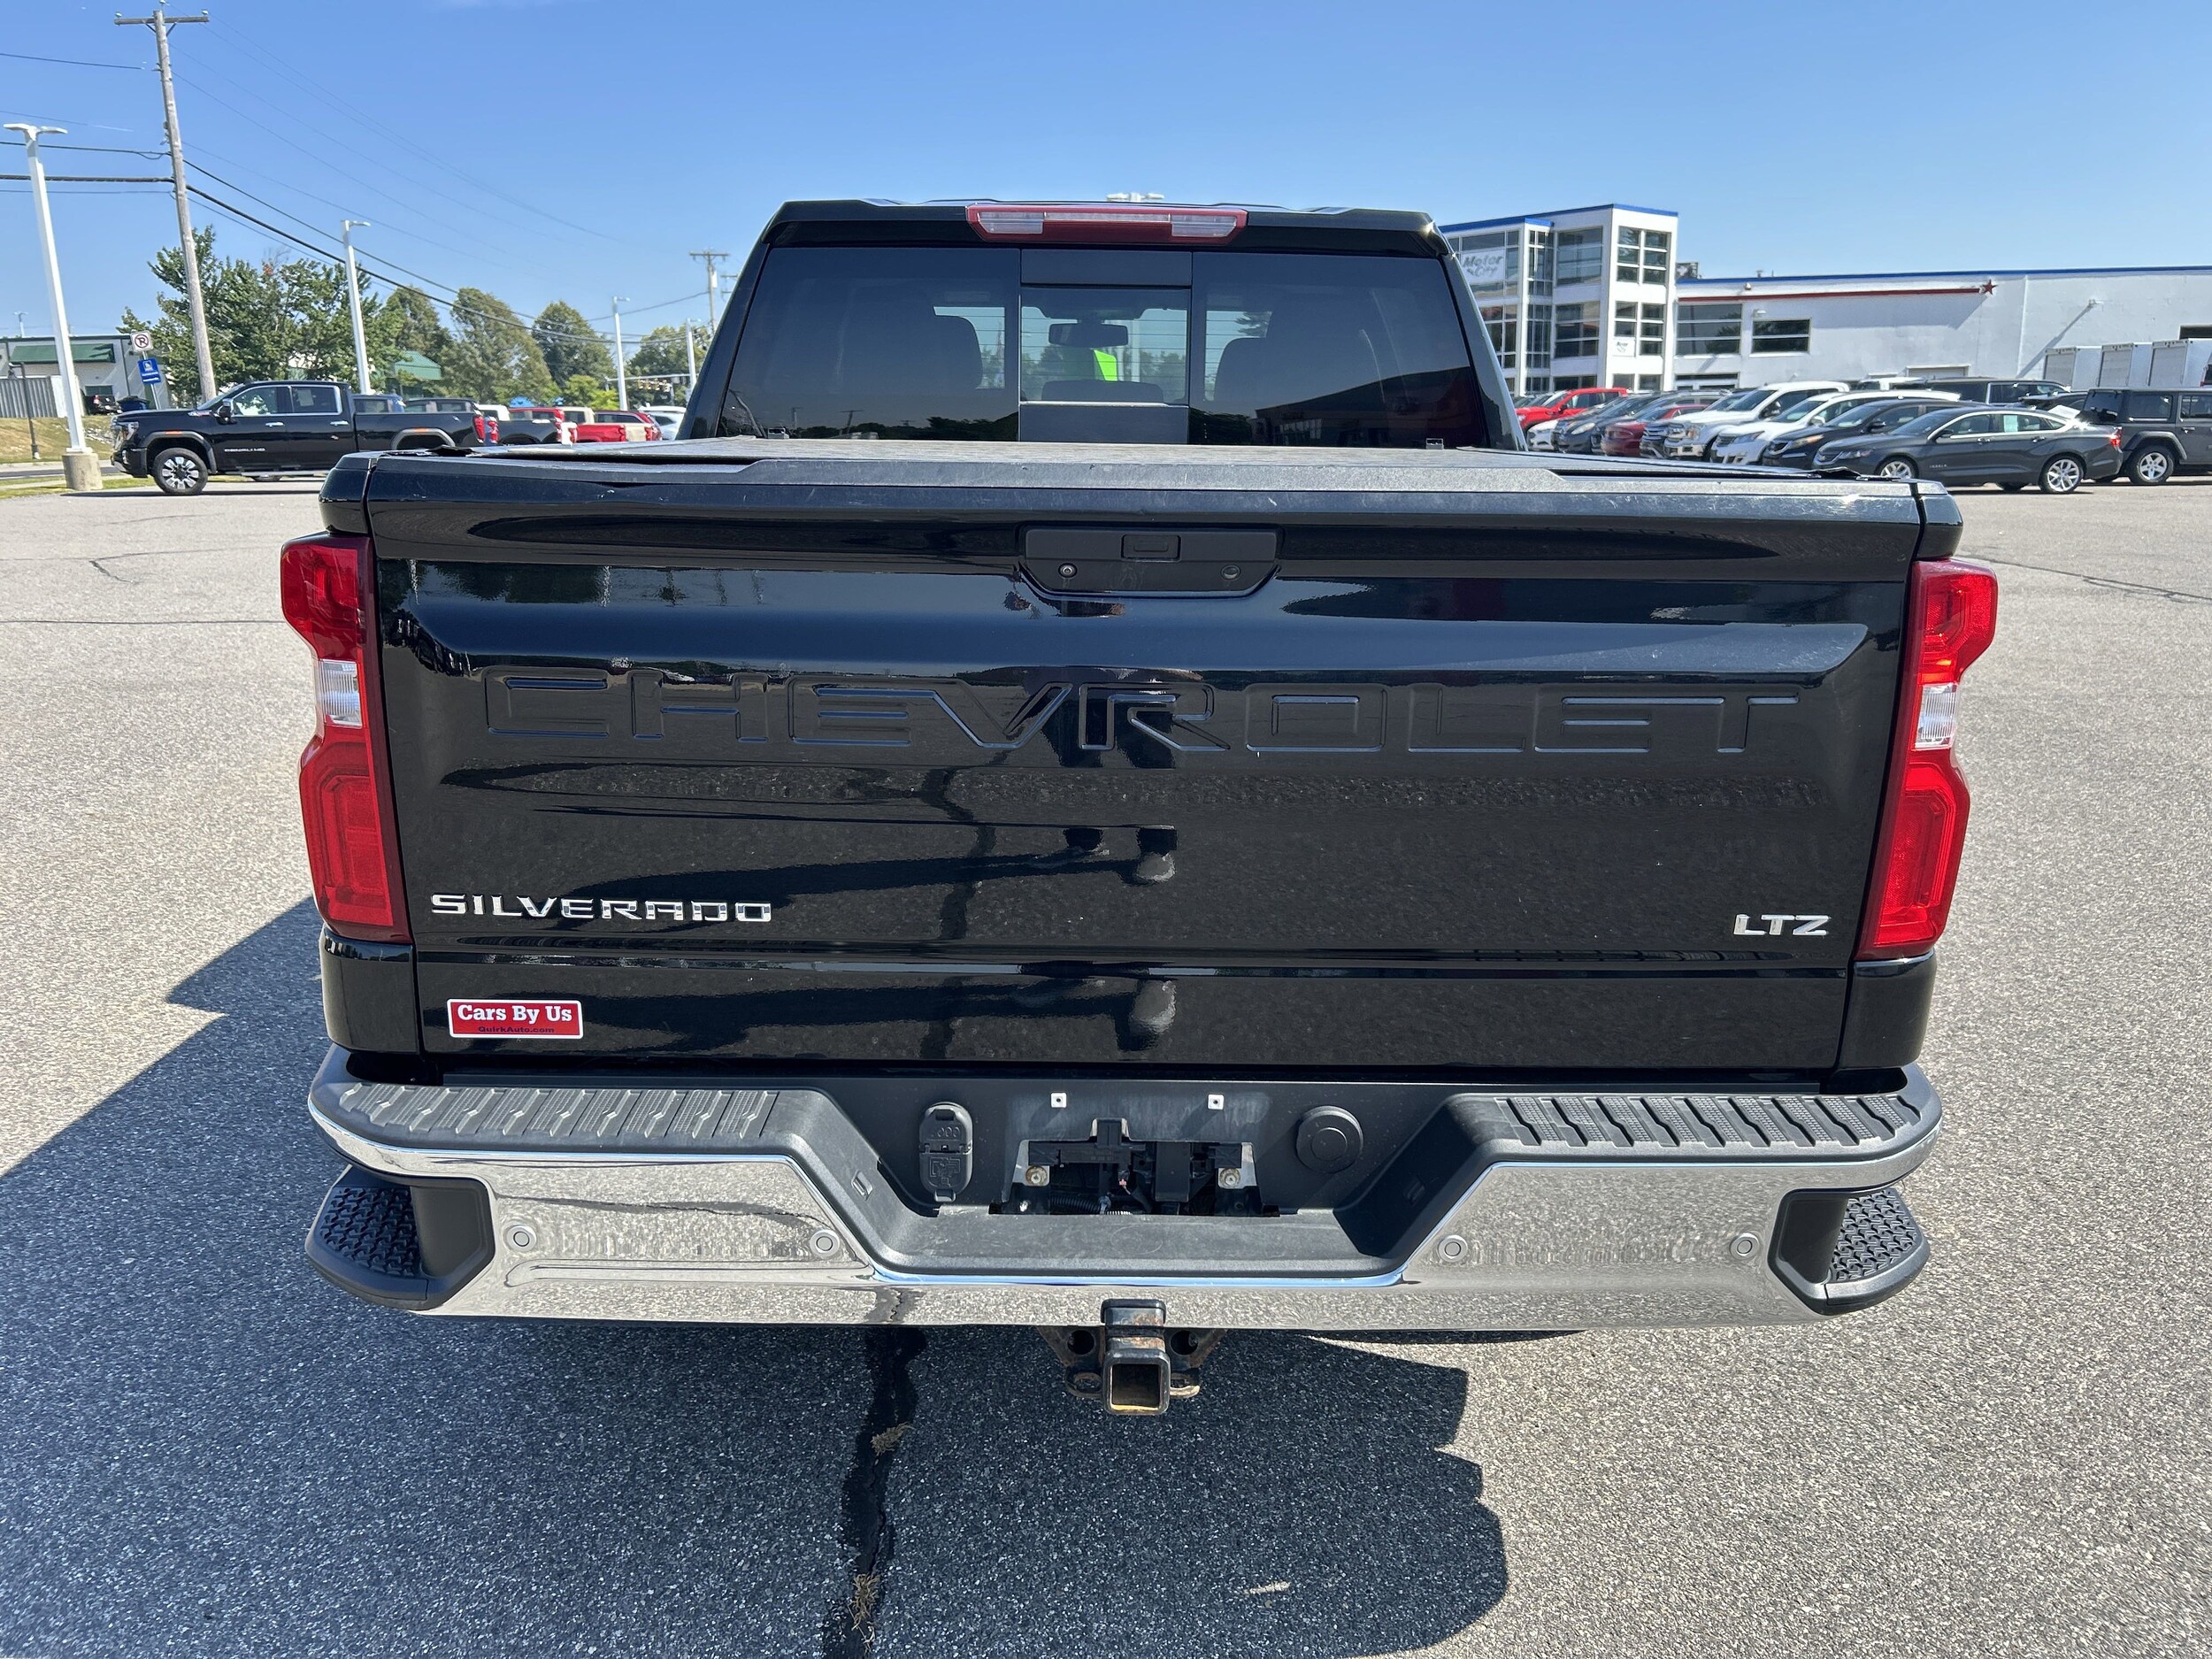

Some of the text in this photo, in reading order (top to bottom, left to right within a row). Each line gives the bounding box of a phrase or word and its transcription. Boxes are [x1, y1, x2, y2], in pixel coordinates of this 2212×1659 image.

[482, 665, 1801, 753] CHEVROLET
[431, 894, 772, 922] SILVERADO
[1733, 914, 1832, 935] LTZ
[457, 1004, 572, 1024] Cars By Us
